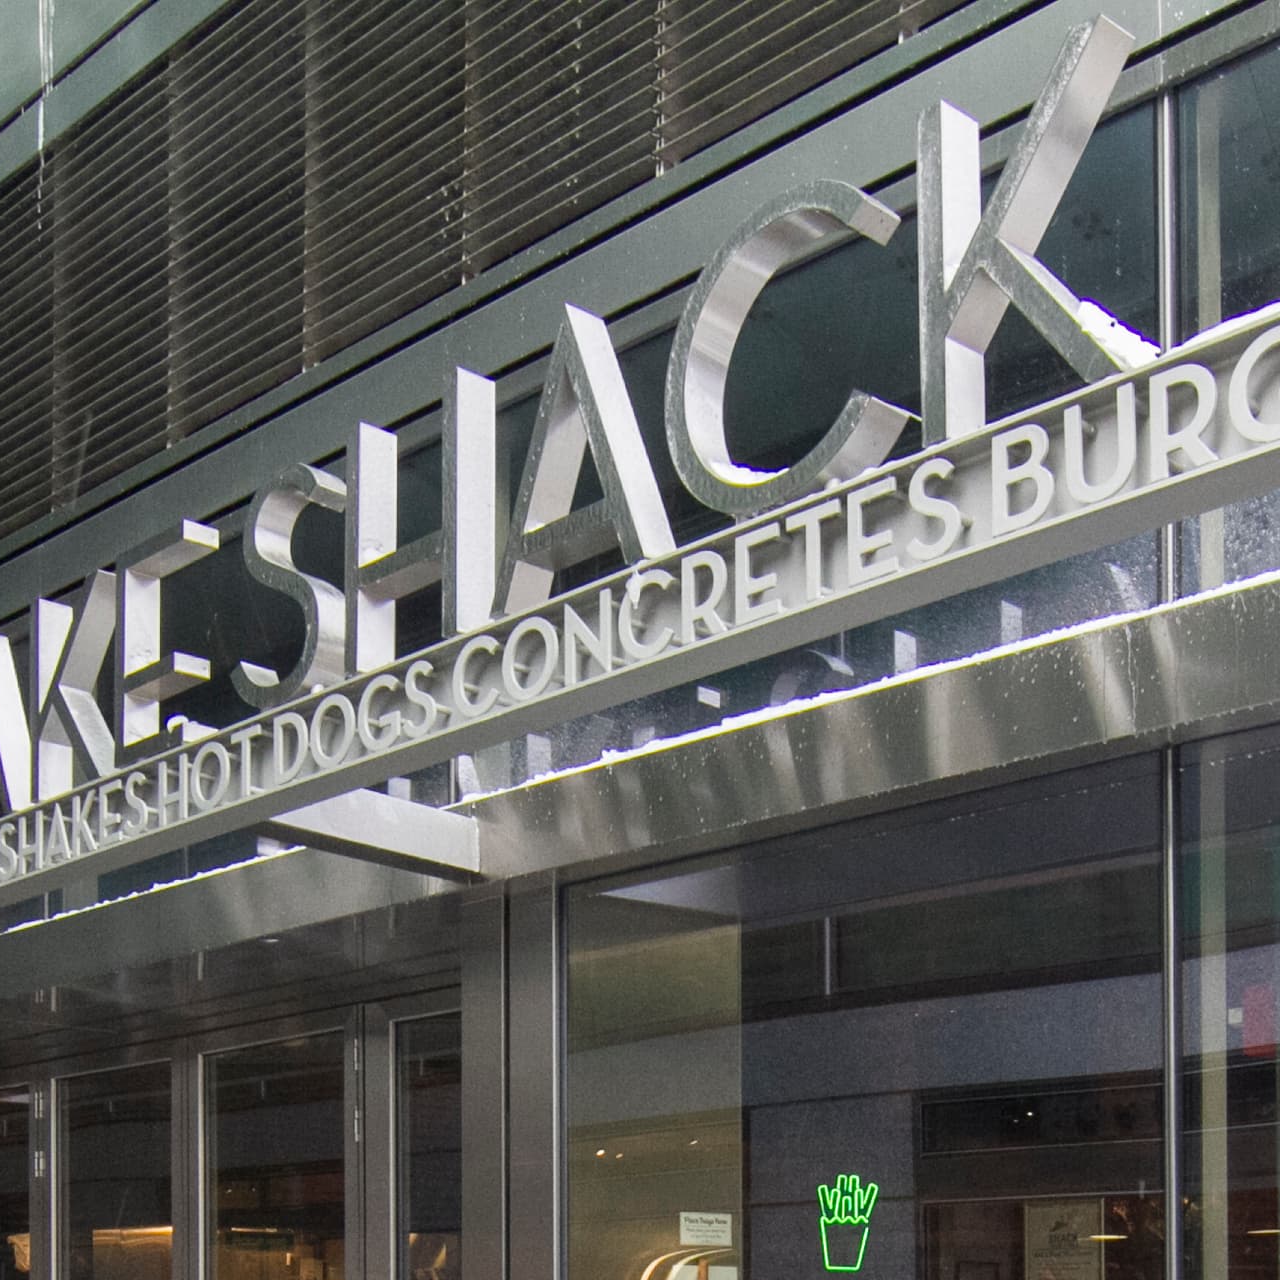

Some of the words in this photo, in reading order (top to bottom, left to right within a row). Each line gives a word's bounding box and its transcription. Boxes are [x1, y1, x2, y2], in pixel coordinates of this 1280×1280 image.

[236, 12, 1161, 710] SHACK
[157, 723, 263, 828] HOT
[273, 659, 438, 786] DOGS
[452, 457, 962, 718] CONCRETES
